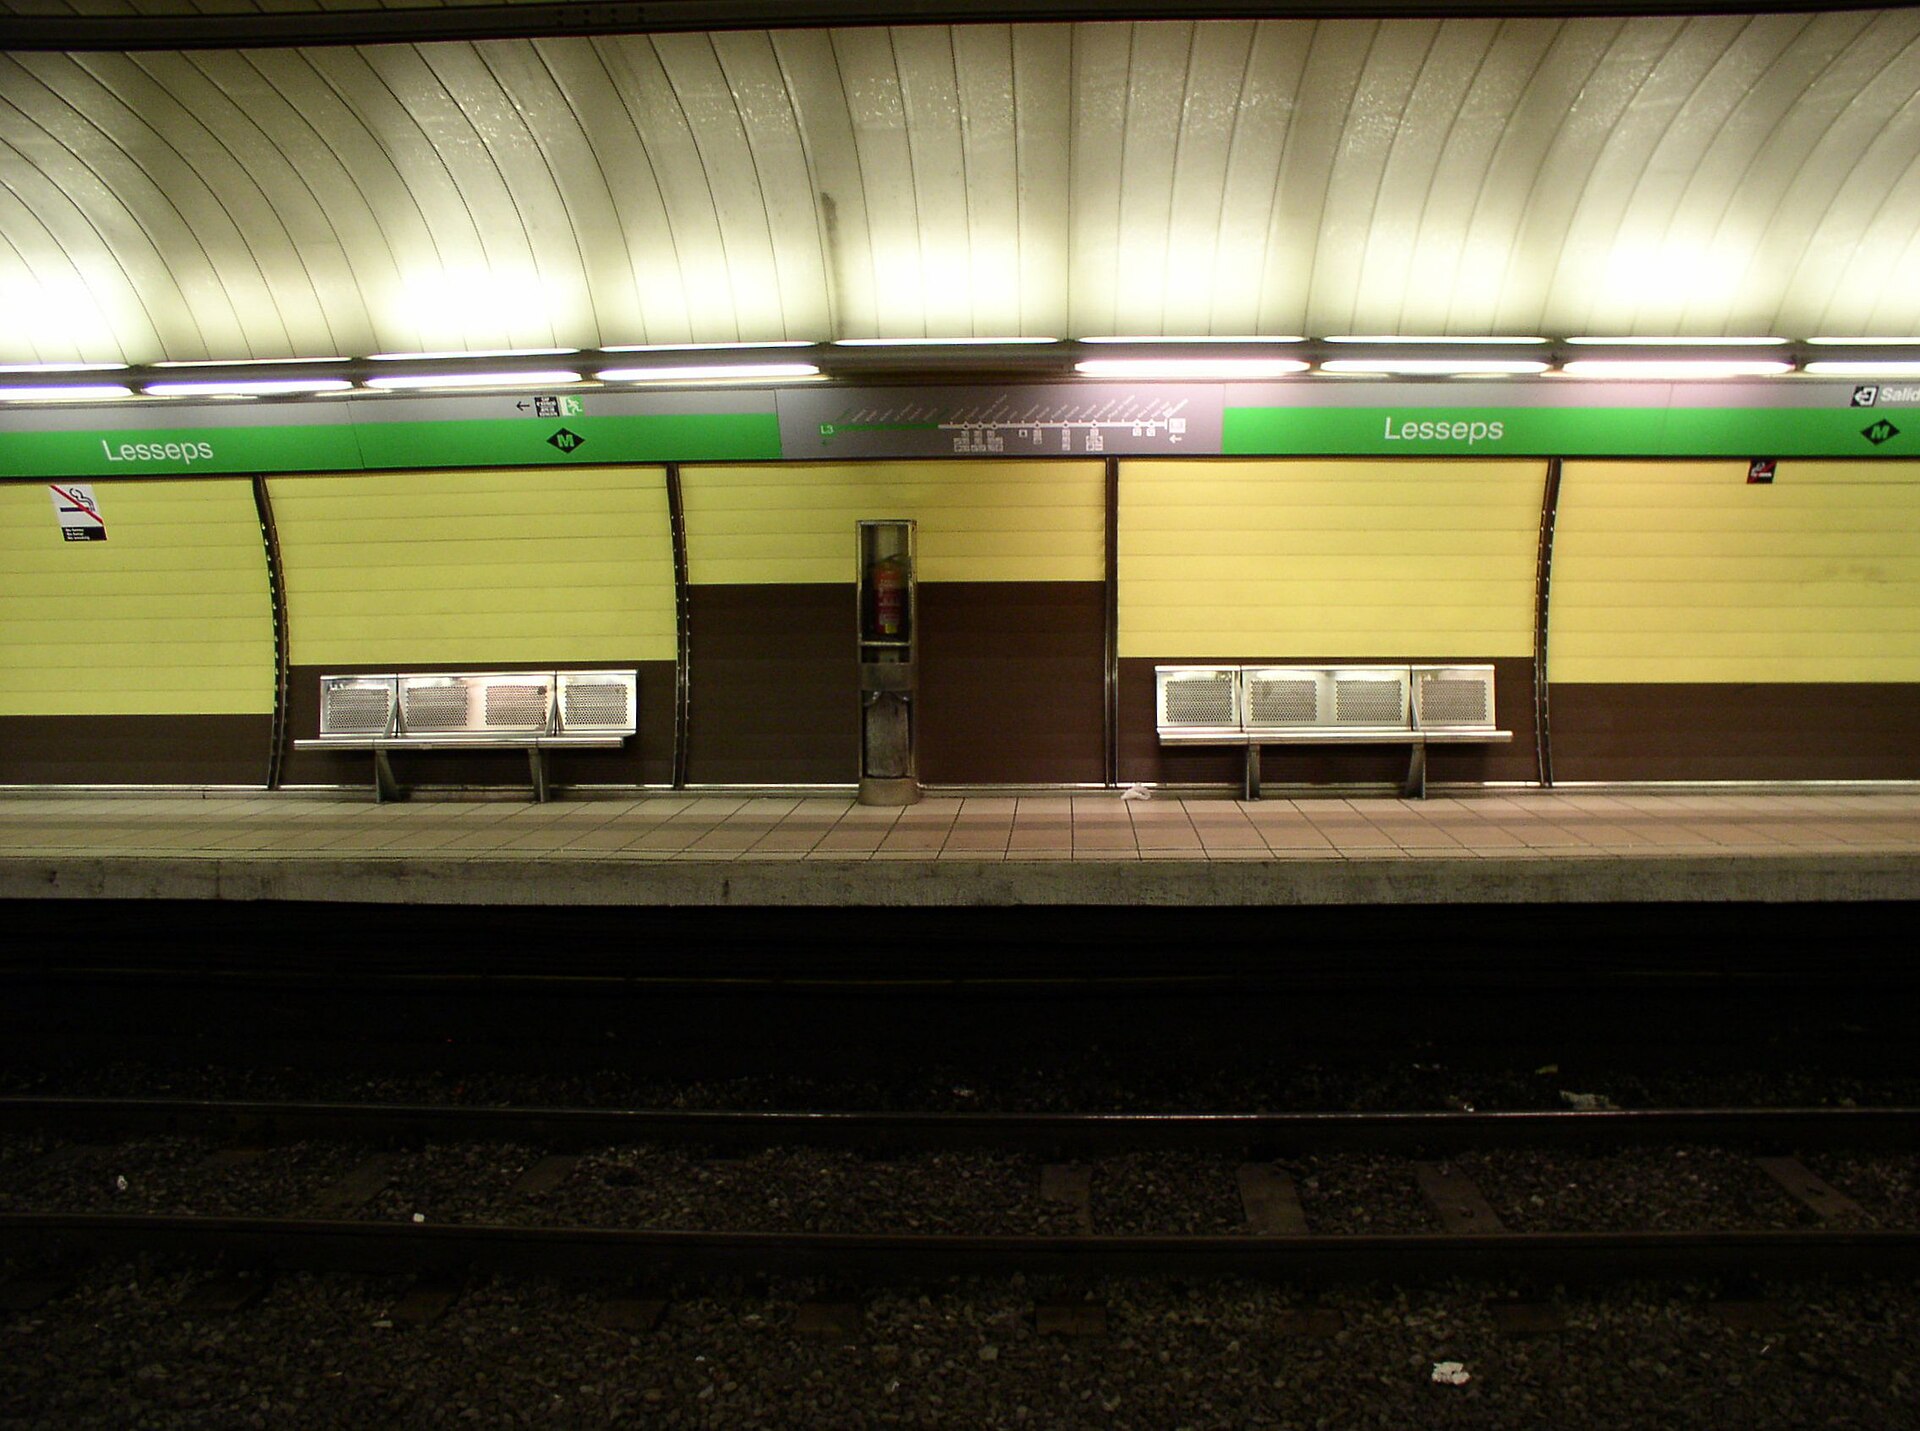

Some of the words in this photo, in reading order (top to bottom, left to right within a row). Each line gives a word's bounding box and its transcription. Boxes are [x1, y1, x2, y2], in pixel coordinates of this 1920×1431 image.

[820, 424, 834, 435] L3
[1384, 416, 1504, 446] Lesseps
[1871, 424, 1890, 440] M
[557, 433, 575, 448] M
[102, 439, 214, 466] Lesseps
